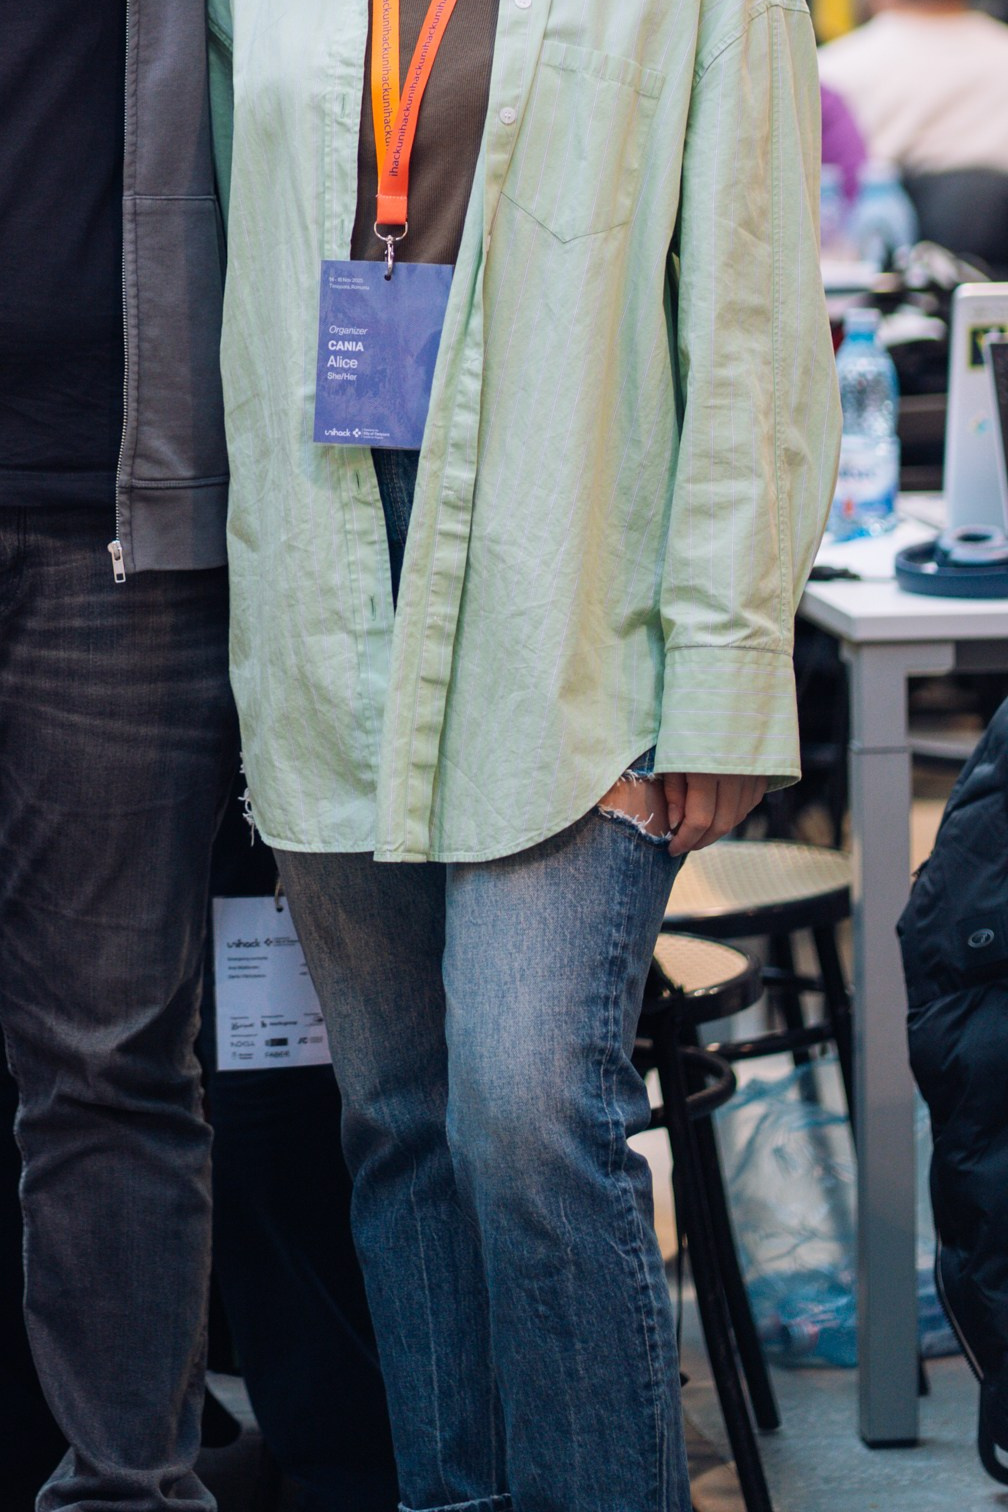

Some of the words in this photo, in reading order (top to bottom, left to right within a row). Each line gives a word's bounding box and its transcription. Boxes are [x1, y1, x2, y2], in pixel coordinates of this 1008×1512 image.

[328, 325, 368, 335] Organizer
[328, 340, 364, 352] CANIA
[327, 355, 358, 369] Alice
[327, 372, 357, 381] She/Her
[324, 427, 351, 437] unihack
[226, 938, 261, 949] unihack
